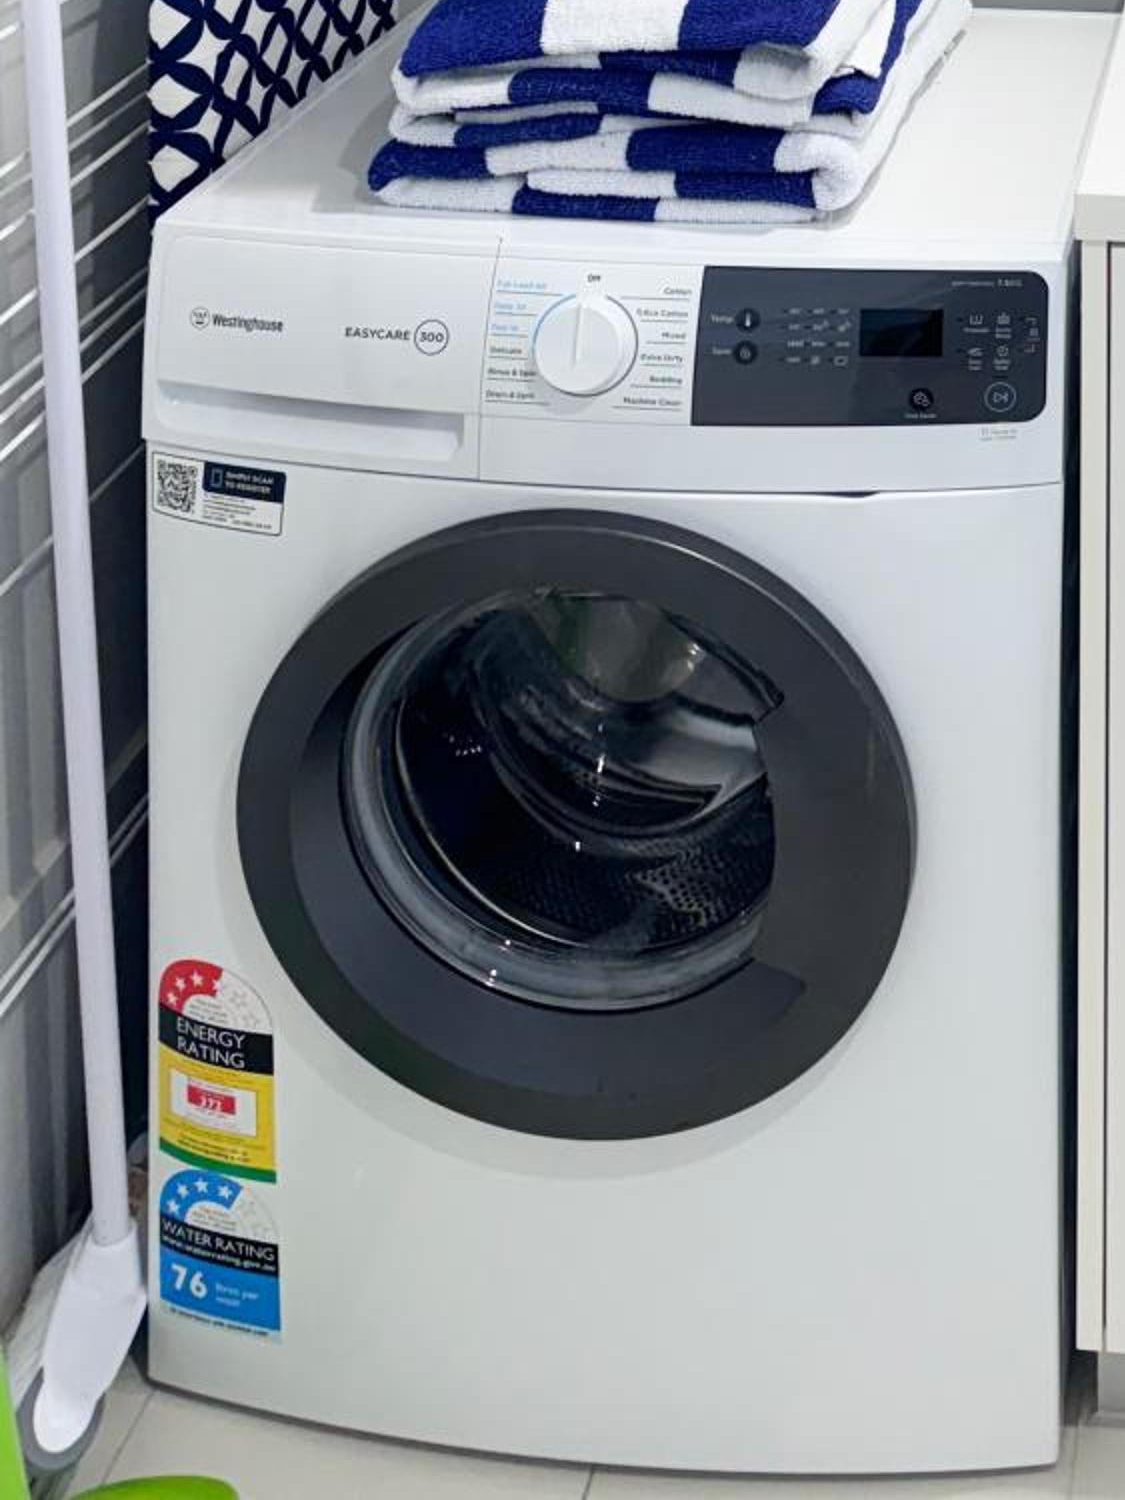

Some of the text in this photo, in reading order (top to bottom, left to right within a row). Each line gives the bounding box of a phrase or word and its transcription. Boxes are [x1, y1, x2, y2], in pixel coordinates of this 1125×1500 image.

[212, 313, 284, 333] Westinghouse
[345, 327, 445, 343] EASYCARE 300
[176, 1017, 246, 1049] ENERGY
[177, 1036, 246, 1068] RATING
[162, 1220, 212, 1248] WATER
[215, 1238, 275, 1261] RATING
[171, 1263, 208, 1299] 76
